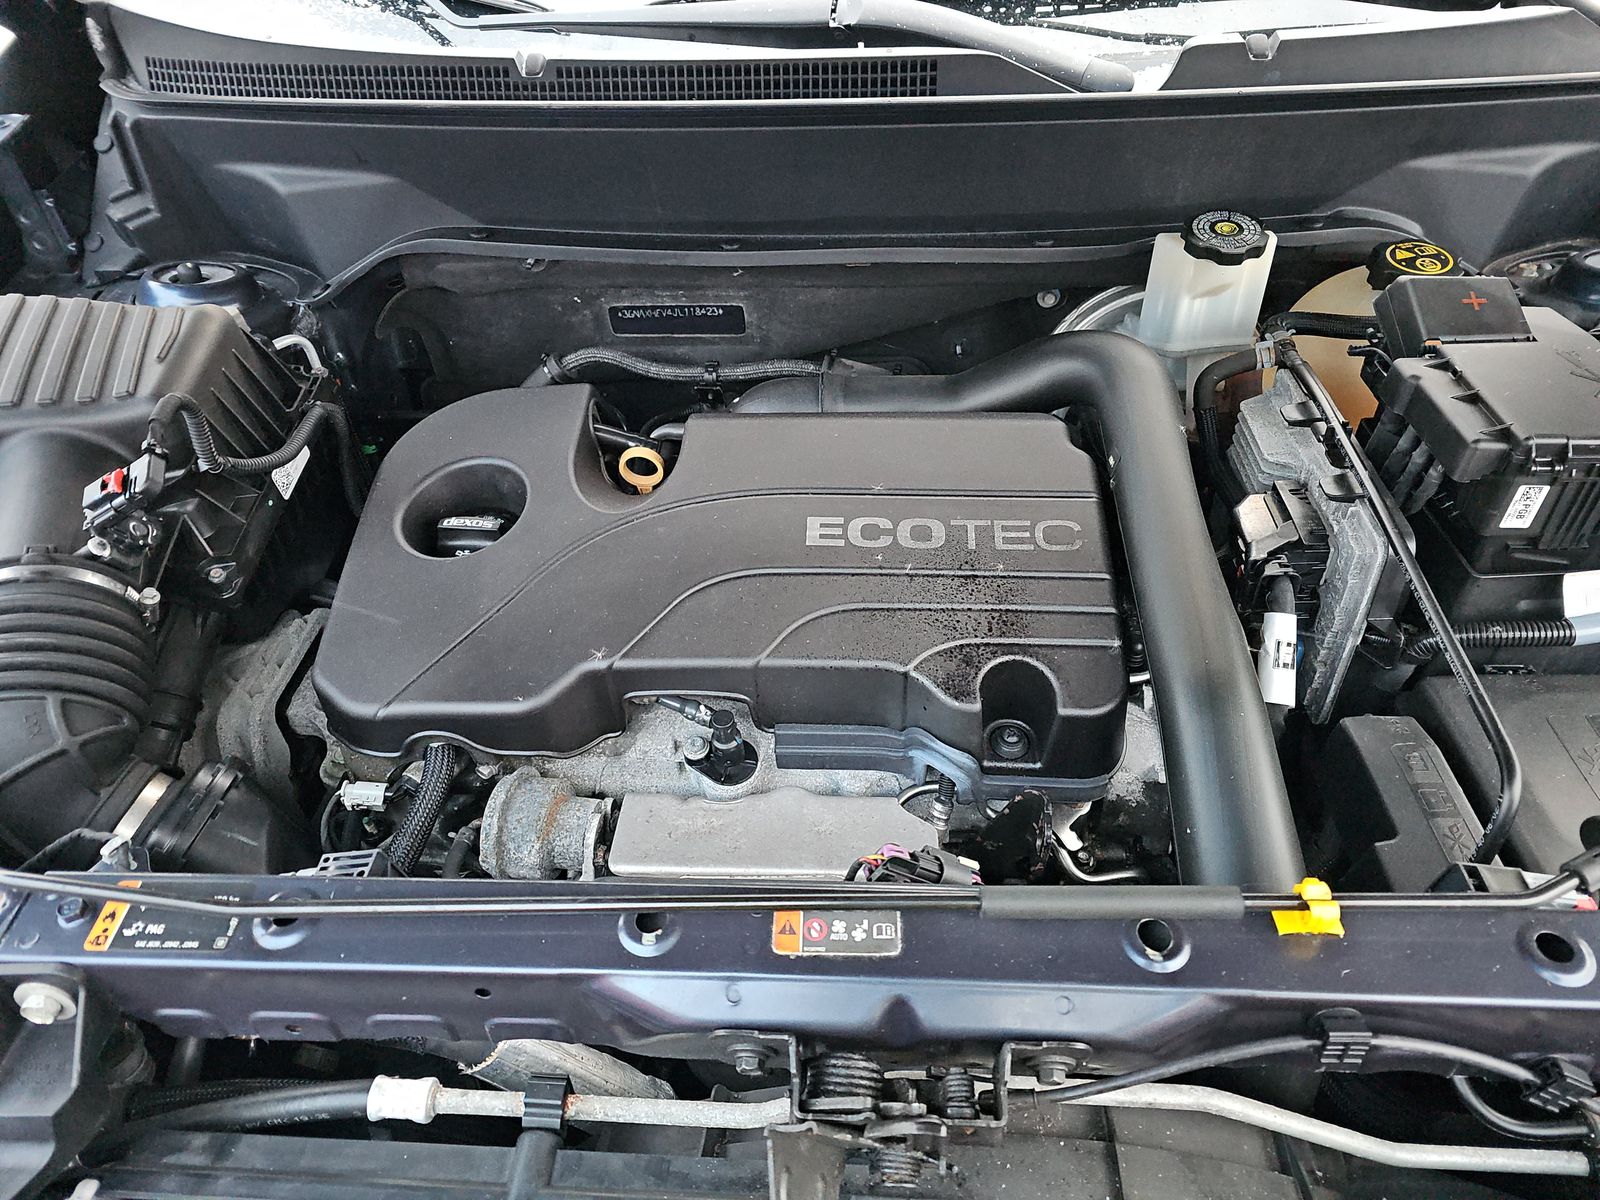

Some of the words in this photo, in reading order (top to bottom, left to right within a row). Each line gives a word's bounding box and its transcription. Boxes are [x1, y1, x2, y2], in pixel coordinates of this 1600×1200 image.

[442, 516, 495, 529] dexos
[805, 516, 1083, 551] ECOTEC
[145, 923, 166, 935] PAG
[829, 933, 848, 941] AUTO
